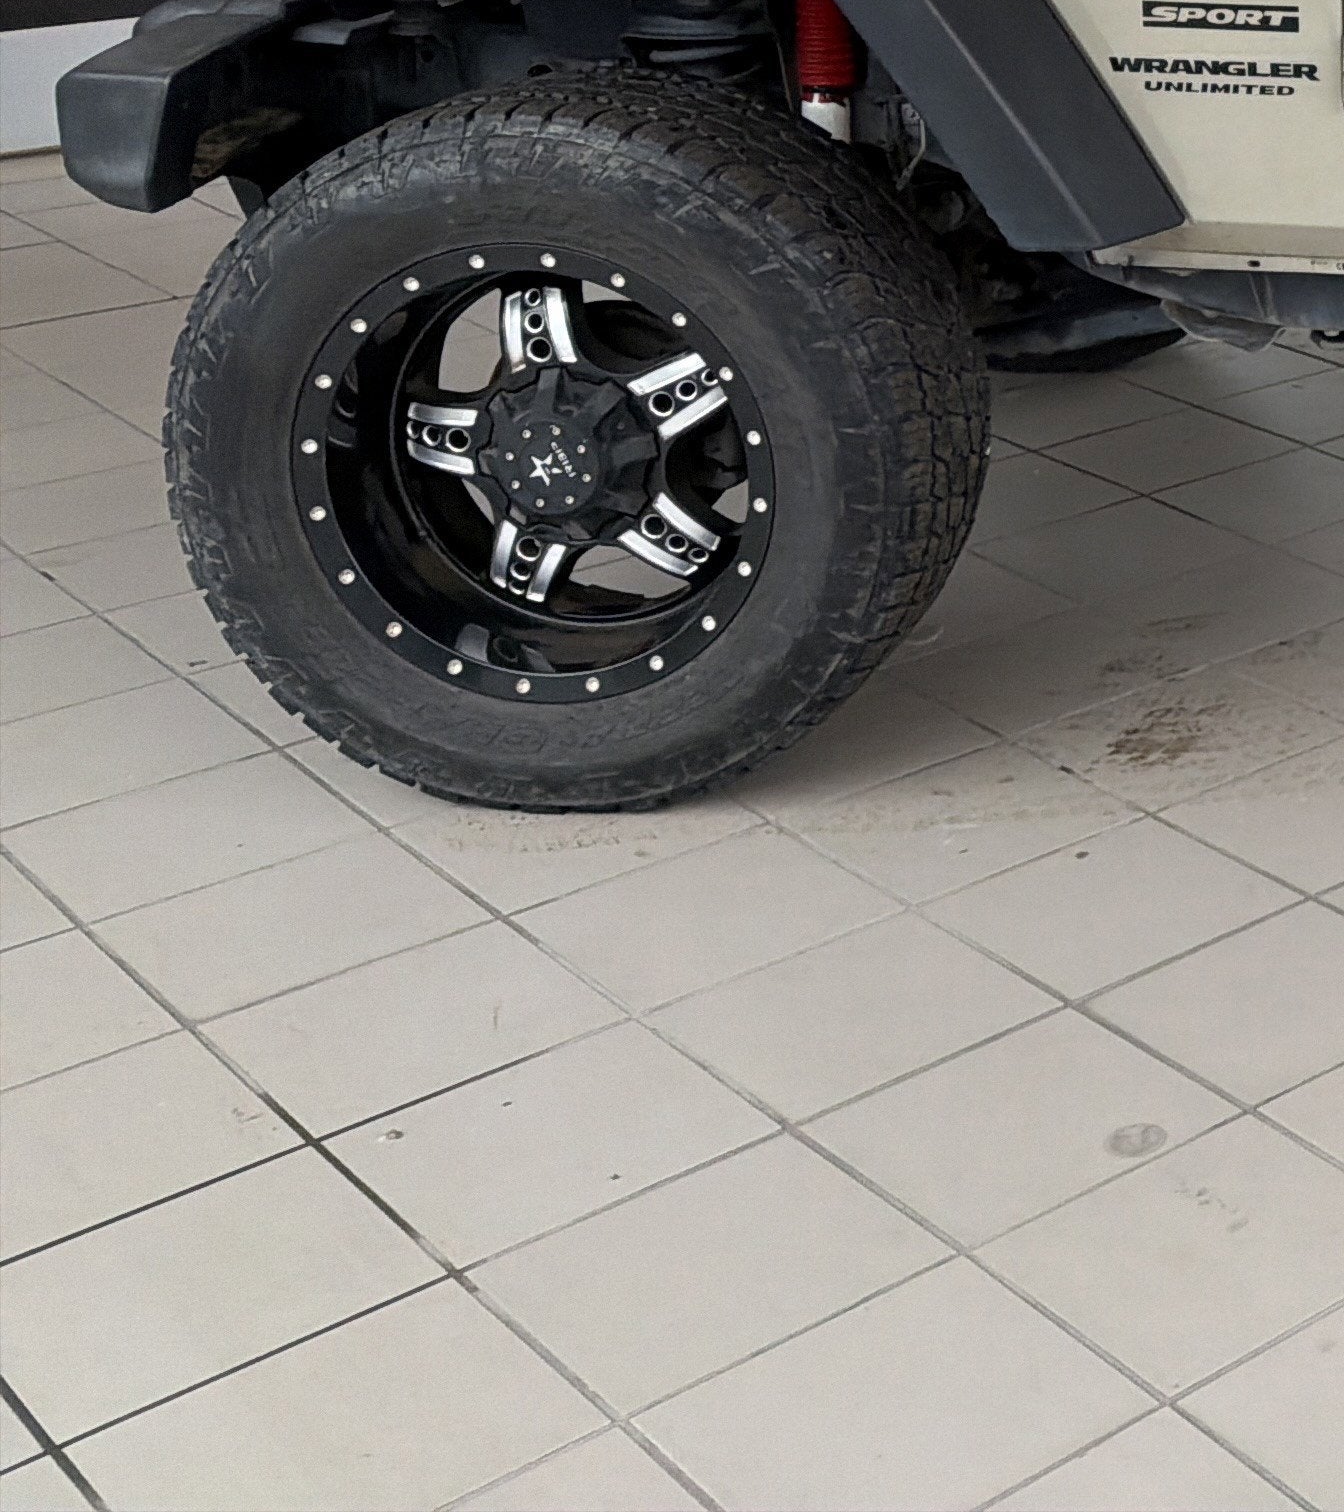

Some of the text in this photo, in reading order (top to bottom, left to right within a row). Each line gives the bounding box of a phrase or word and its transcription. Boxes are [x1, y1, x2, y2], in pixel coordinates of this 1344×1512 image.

[1148, 5, 1291, 27] SPORT
[1108, 56, 1320, 81] WRANGLER
[1144, 80, 1295, 96] UNLIMITED
